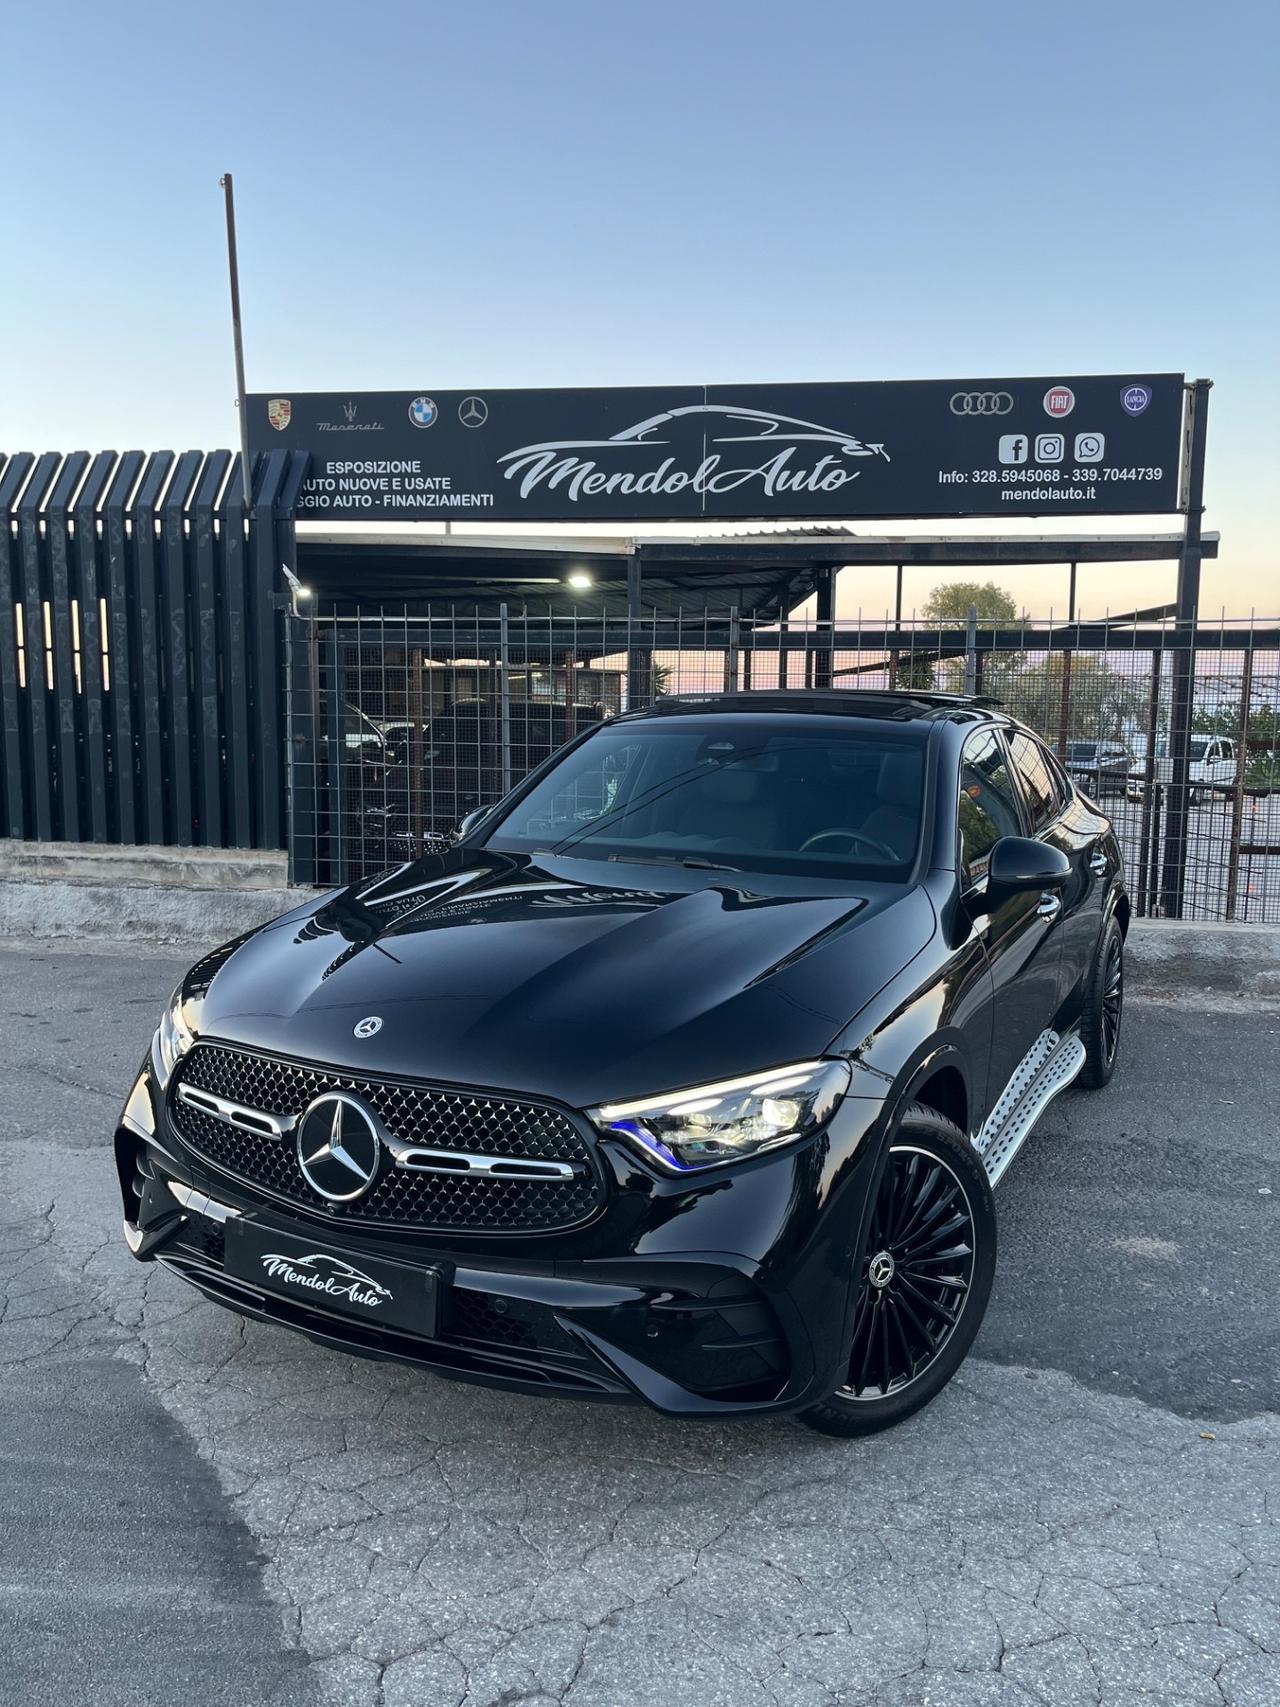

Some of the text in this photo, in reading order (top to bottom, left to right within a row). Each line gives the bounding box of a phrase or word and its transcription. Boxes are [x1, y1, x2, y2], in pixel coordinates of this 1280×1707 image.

[1050, 395, 1069, 409] FIAT
[326, 460, 421, 474] ESPOSIZIONE
[939, 471, 969, 483] Info:
[972, 469, 1061, 483] 328.5945068
[1072, 467, 1163, 481] 339.7044739
[339, 477, 389, 491] NUOVE
[393, 477, 401, 490] E
[404, 476, 452, 490] USATE
[333, 494, 372, 508] AUTO
[383, 493, 494, 507] FINANZIAMENTI
[1001, 486, 1097, 501] mendolauto.it
